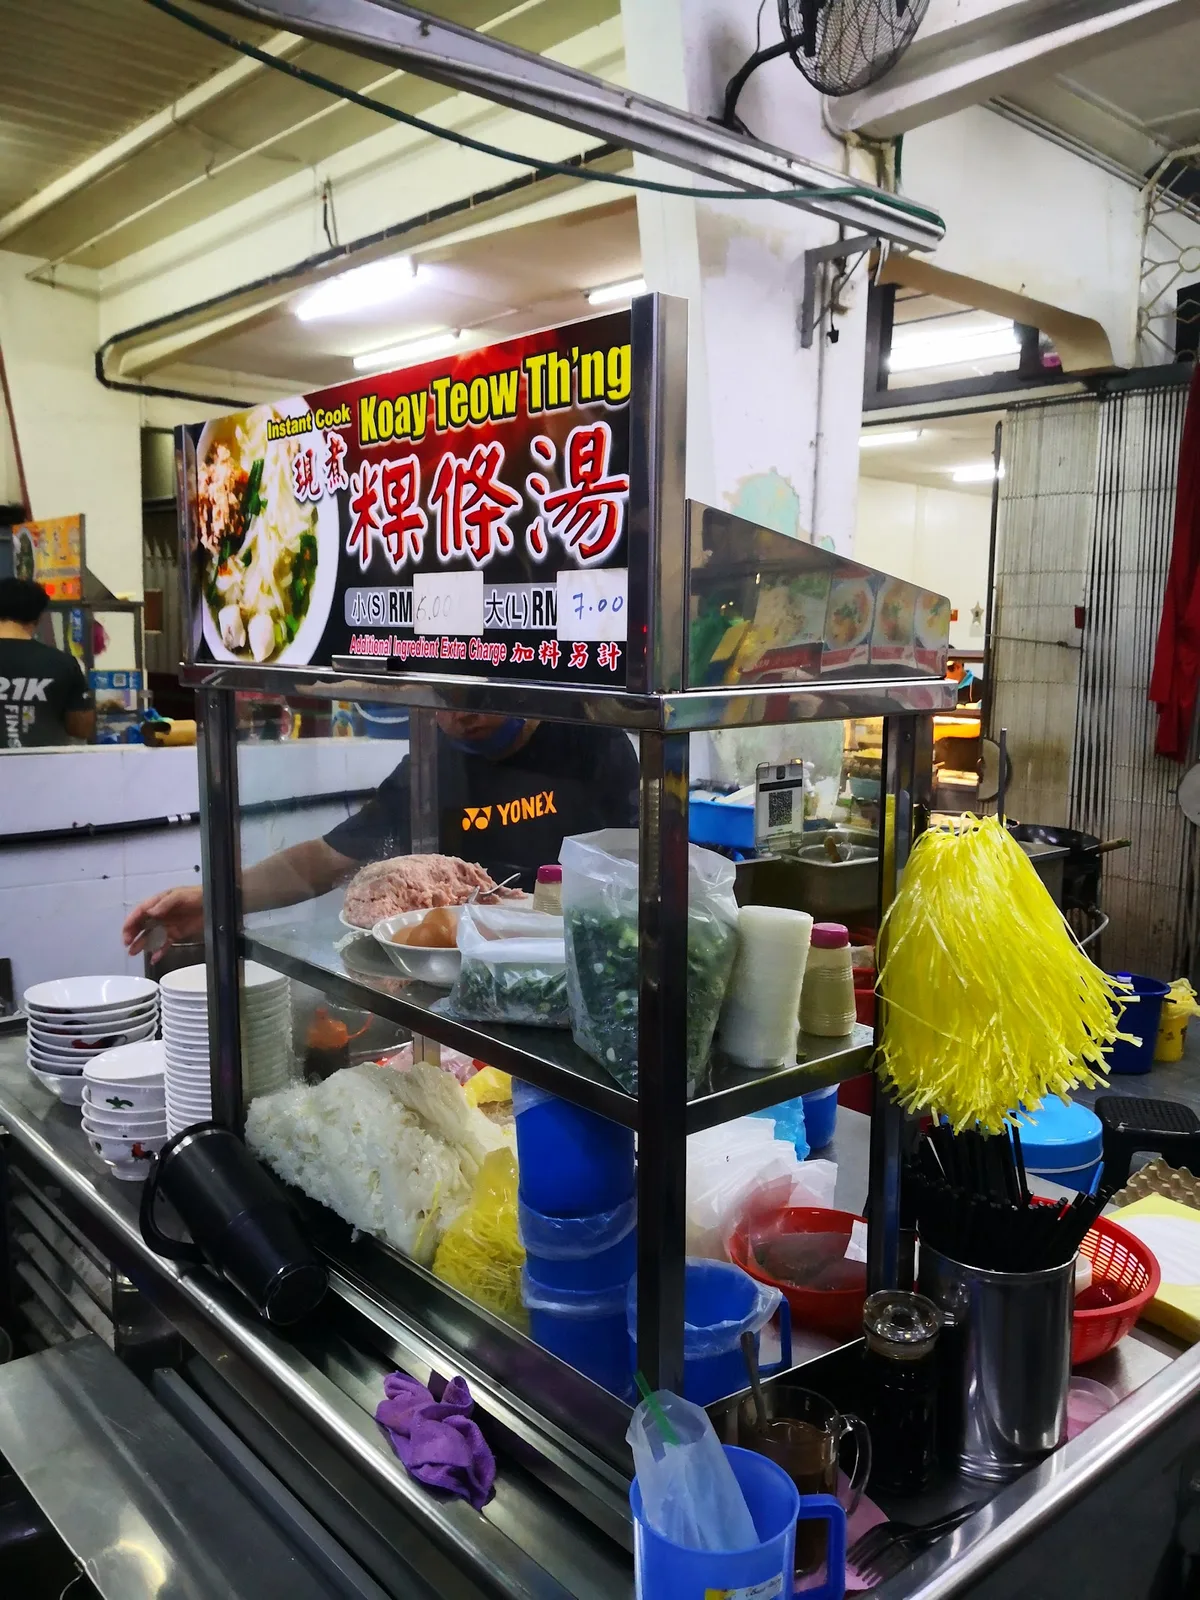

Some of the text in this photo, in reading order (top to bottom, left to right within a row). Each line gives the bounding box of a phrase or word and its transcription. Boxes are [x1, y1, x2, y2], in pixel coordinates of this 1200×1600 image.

[360, 344, 632, 443] Koay Teow Th'ng
[267, 403, 351, 440] Instant Cook
[294, 435, 347, 497] 現煮
[349, 425, 629, 565] 粿條湯
[389, 591, 413, 623] RM
[416, 595, 452, 621] 6.00
[572, 592, 624, 620] 7.00
[350, 634, 622, 670] Additional Ingredient Extra Charge 加料另計
[496, 790, 557, 826] YONEX
